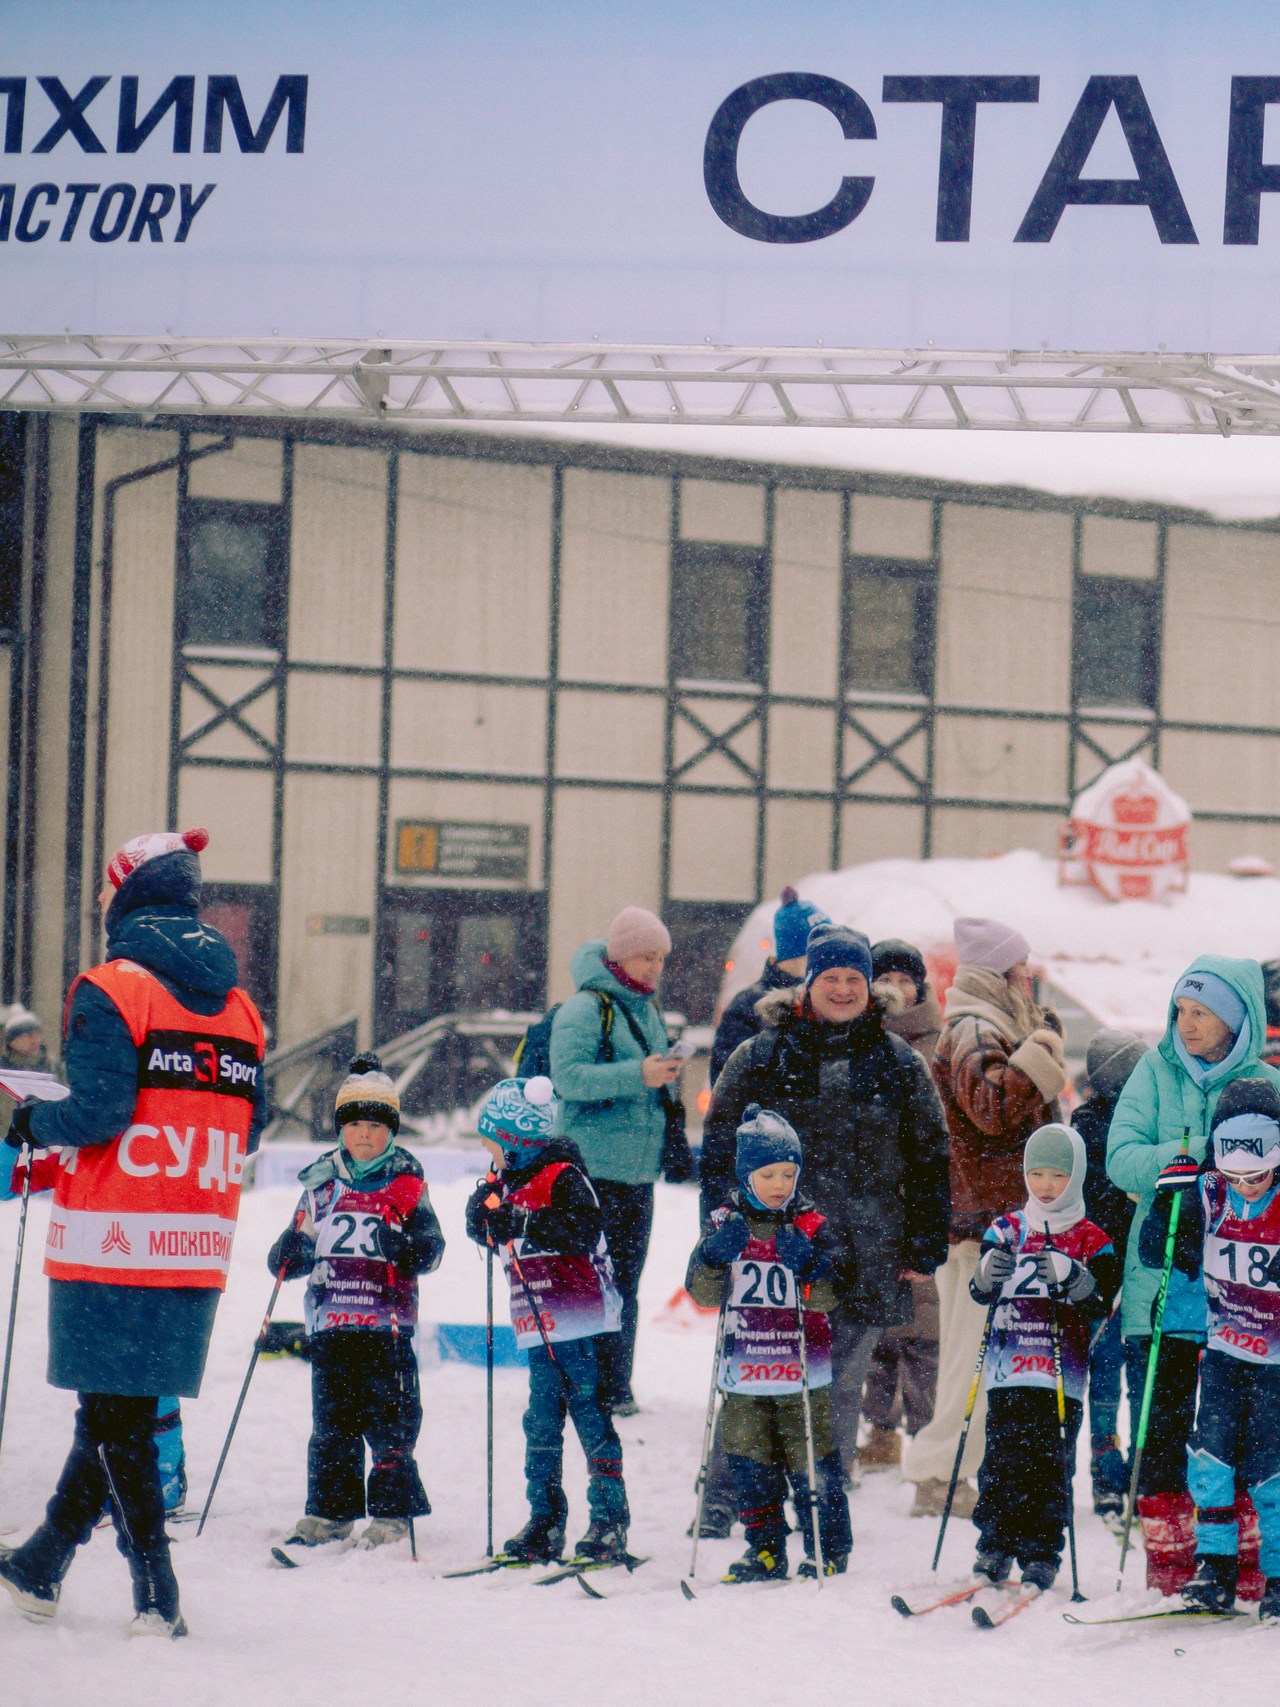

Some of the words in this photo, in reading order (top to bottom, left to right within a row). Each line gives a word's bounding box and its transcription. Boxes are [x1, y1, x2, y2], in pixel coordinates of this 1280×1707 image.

[148, 1048, 192, 1072] Arta
[219, 1055, 257, 1087] Sport
[117, 1124, 245, 1193] СУДЬ
[1220, 1138, 1263, 1158] TOPSKI
[330, 1214, 381, 1257] 23
[741, 1262, 787, 1306] 20
[1219, 1242, 1271, 1288] 18
[739, 1361, 801, 1381] 2026
